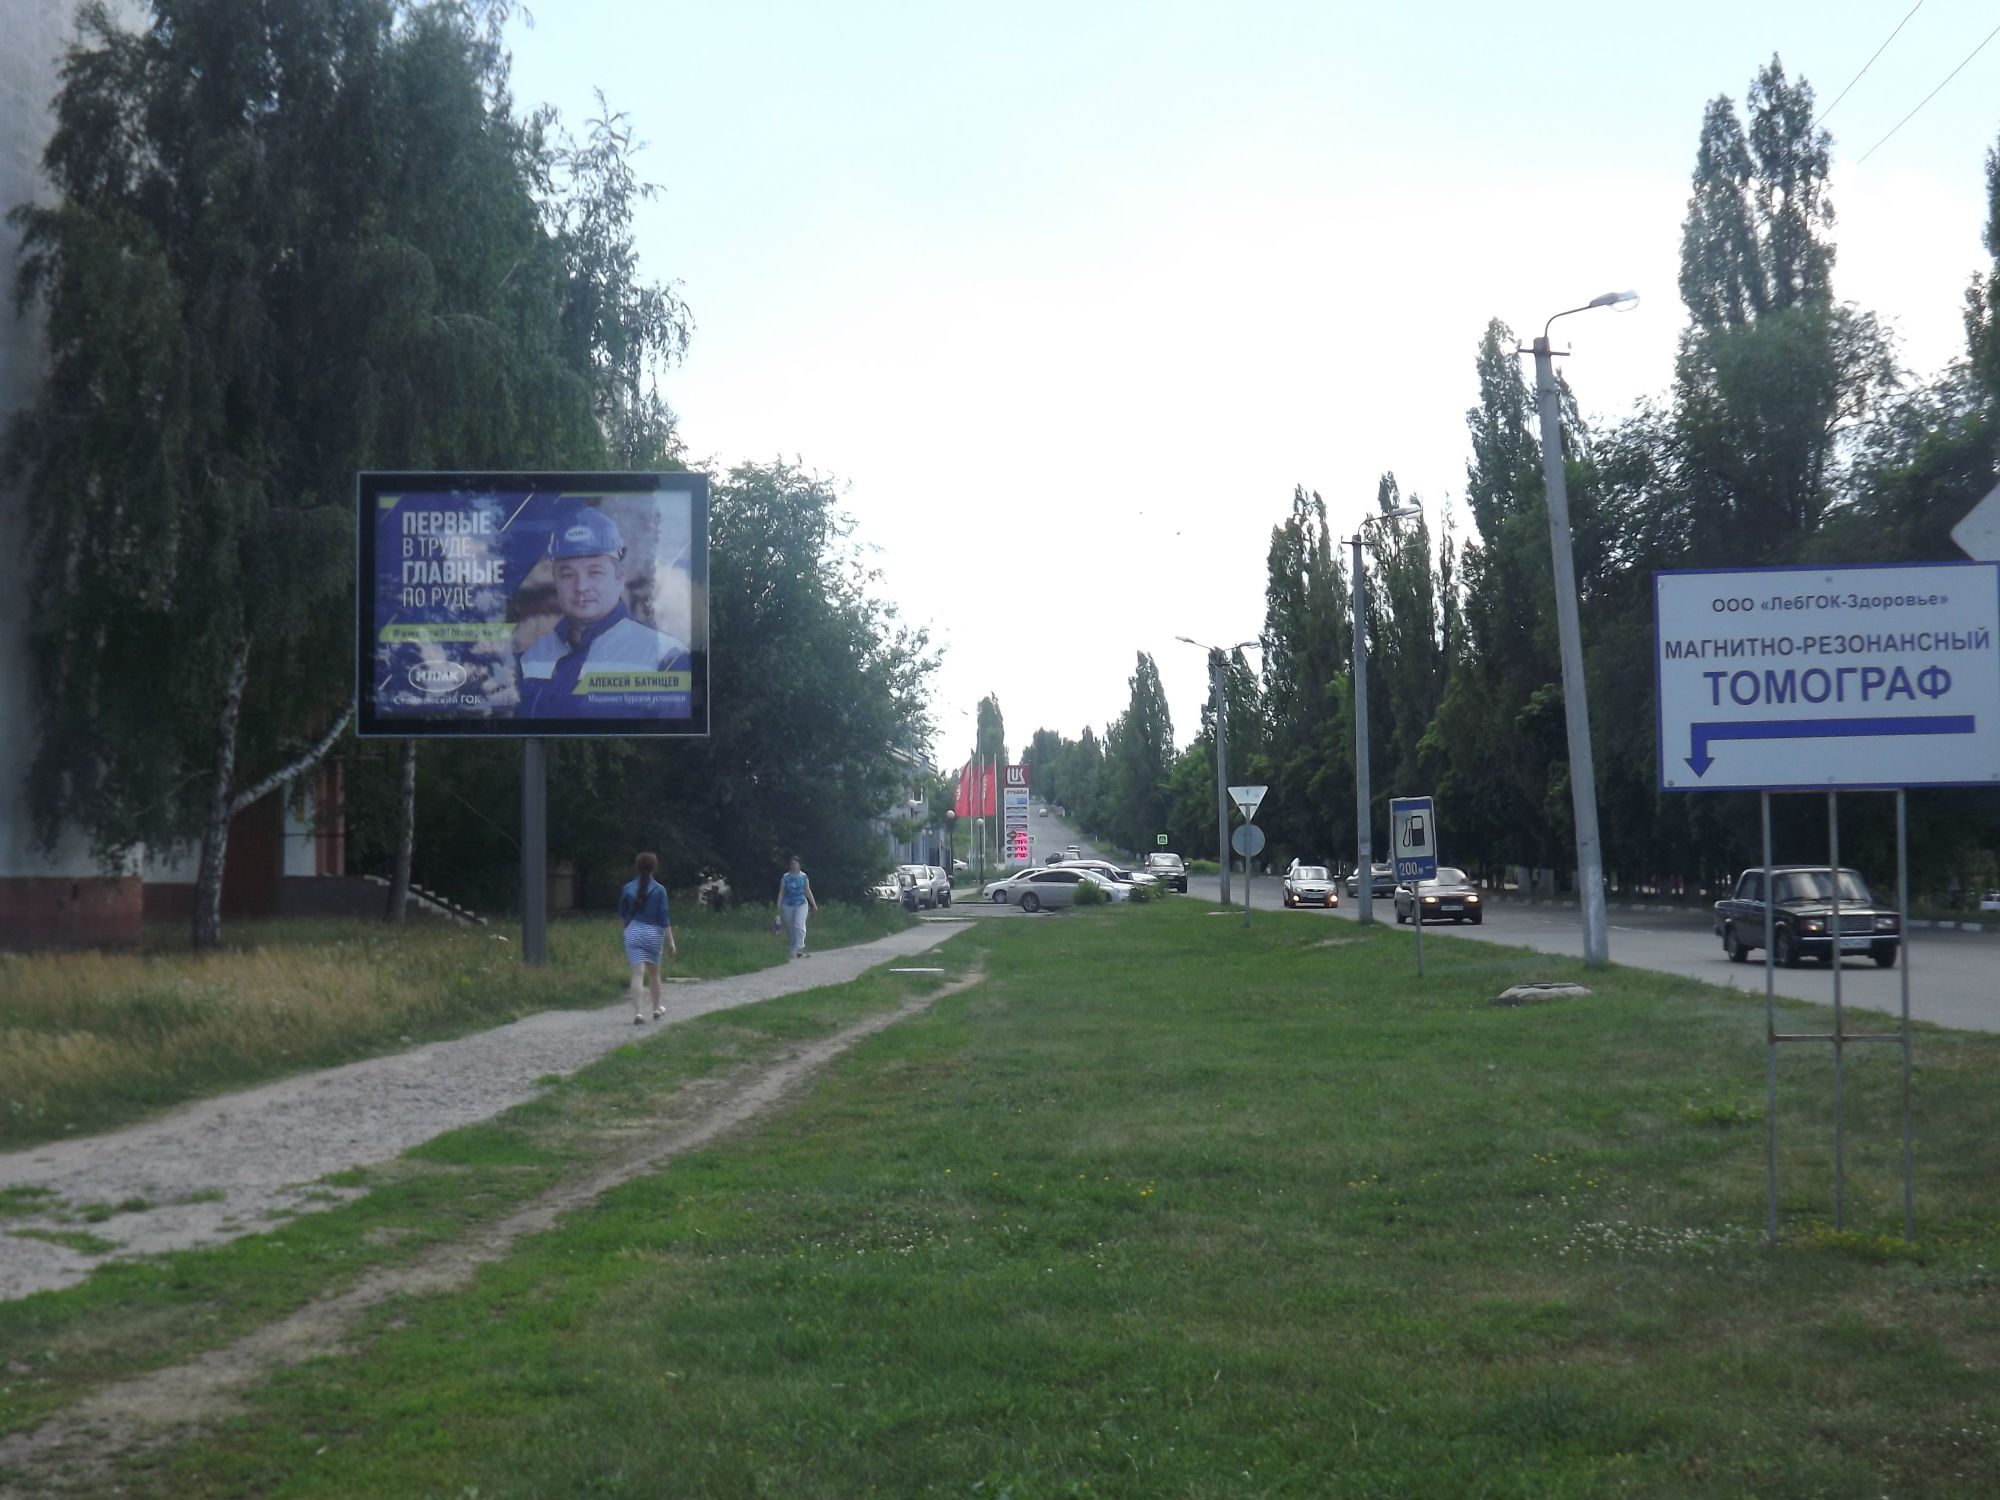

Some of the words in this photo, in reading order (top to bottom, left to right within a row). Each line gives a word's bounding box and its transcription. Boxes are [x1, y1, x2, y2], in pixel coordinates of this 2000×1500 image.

[402, 511, 491, 535] ПЕРВЫЕ
[402, 537, 414, 557] В
[418, 537, 476, 558] ТРУДЕ,
[402, 560, 505, 584] ГЛАВНЫЕ
[402, 587, 425, 608] ПО
[431, 587, 475, 609] РУДЕ
[1712, 598, 1754, 613] ООО
[1761, 593, 1949, 612] «ЛебГОК-Здоровье»
[1665, 627, 1990, 659] МАГНИТНО-РЕЗОНАНСНЫЙ
[589, 675, 631, 687] АЛЕКСЕЙ
[635, 677, 680, 688] БАТИЩЕВ
[1703, 665, 1952, 706] ТОМОГРАФ
[461, 695, 481, 704] ГОК
[1399, 862, 1418, 876] 200
